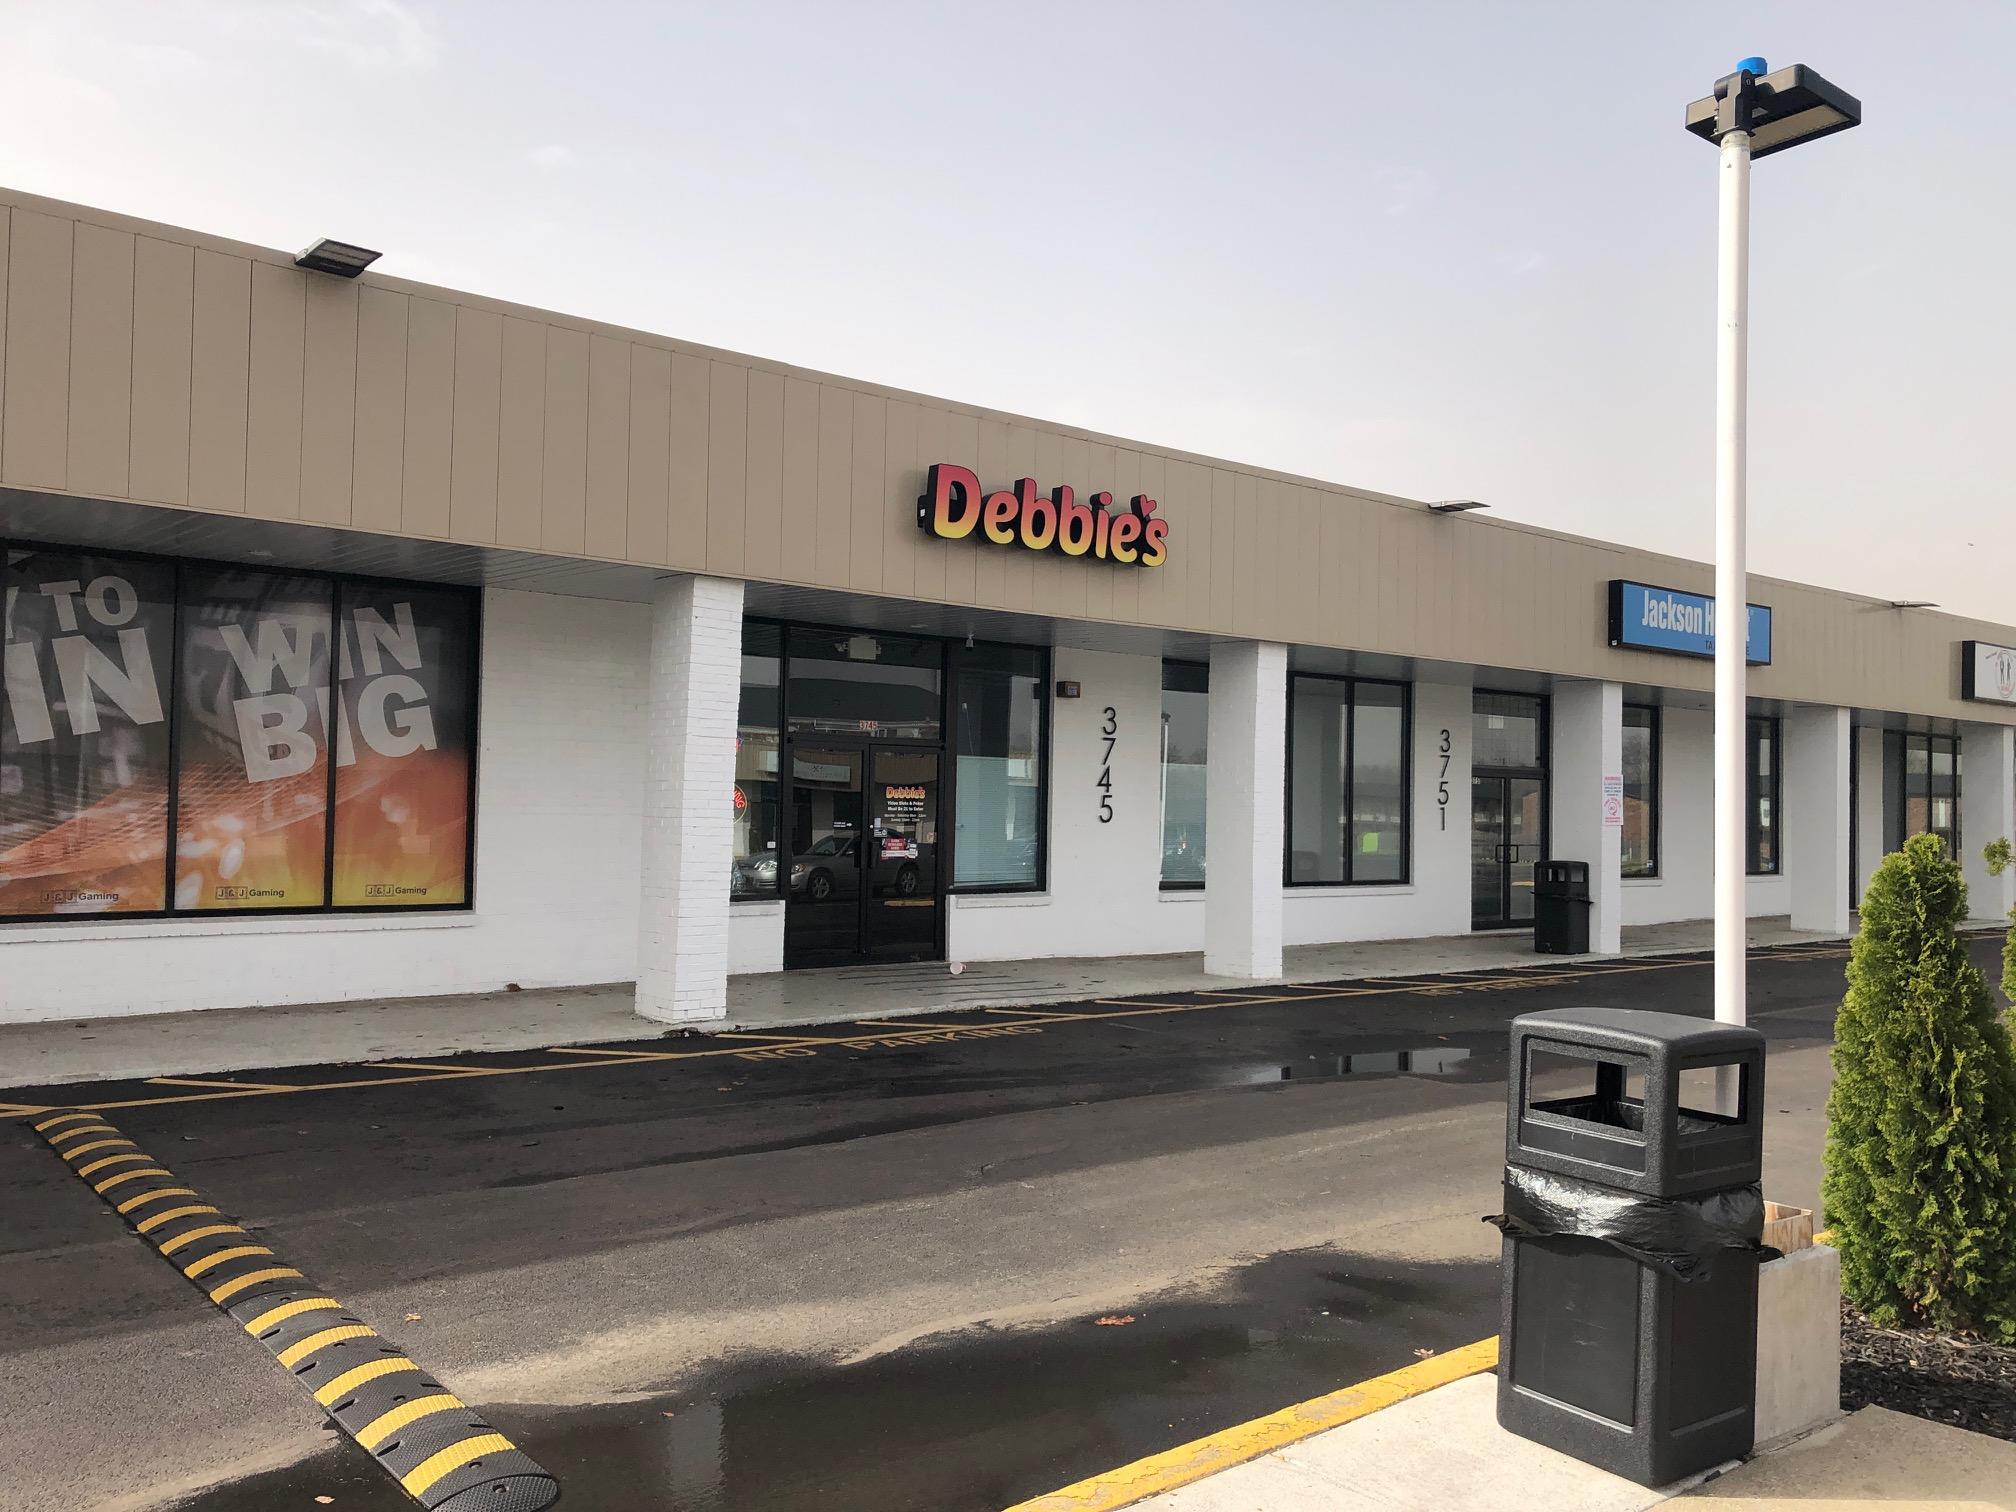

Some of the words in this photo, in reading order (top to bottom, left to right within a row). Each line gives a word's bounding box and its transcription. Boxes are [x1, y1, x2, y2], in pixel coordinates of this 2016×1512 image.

[930, 463, 1168, 567] Debbie's
[39, 575, 138, 631] TO
[1642, 590, 1703, 634] Jackson
[218, 602, 422, 694] WIN
[233, 674, 437, 783] BIG
[1096, 706, 1118, 823] 3745
[1437, 729, 1451, 831] 3751
[886, 786, 926, 799] Debbie's
[79, 892, 119, 902] Gaming
[249, 889, 285, 898] Gaming
[395, 887, 427, 895] Gaming
[733, 1048, 817, 1062] NO
[841, 1026, 1044, 1050] PARKING
